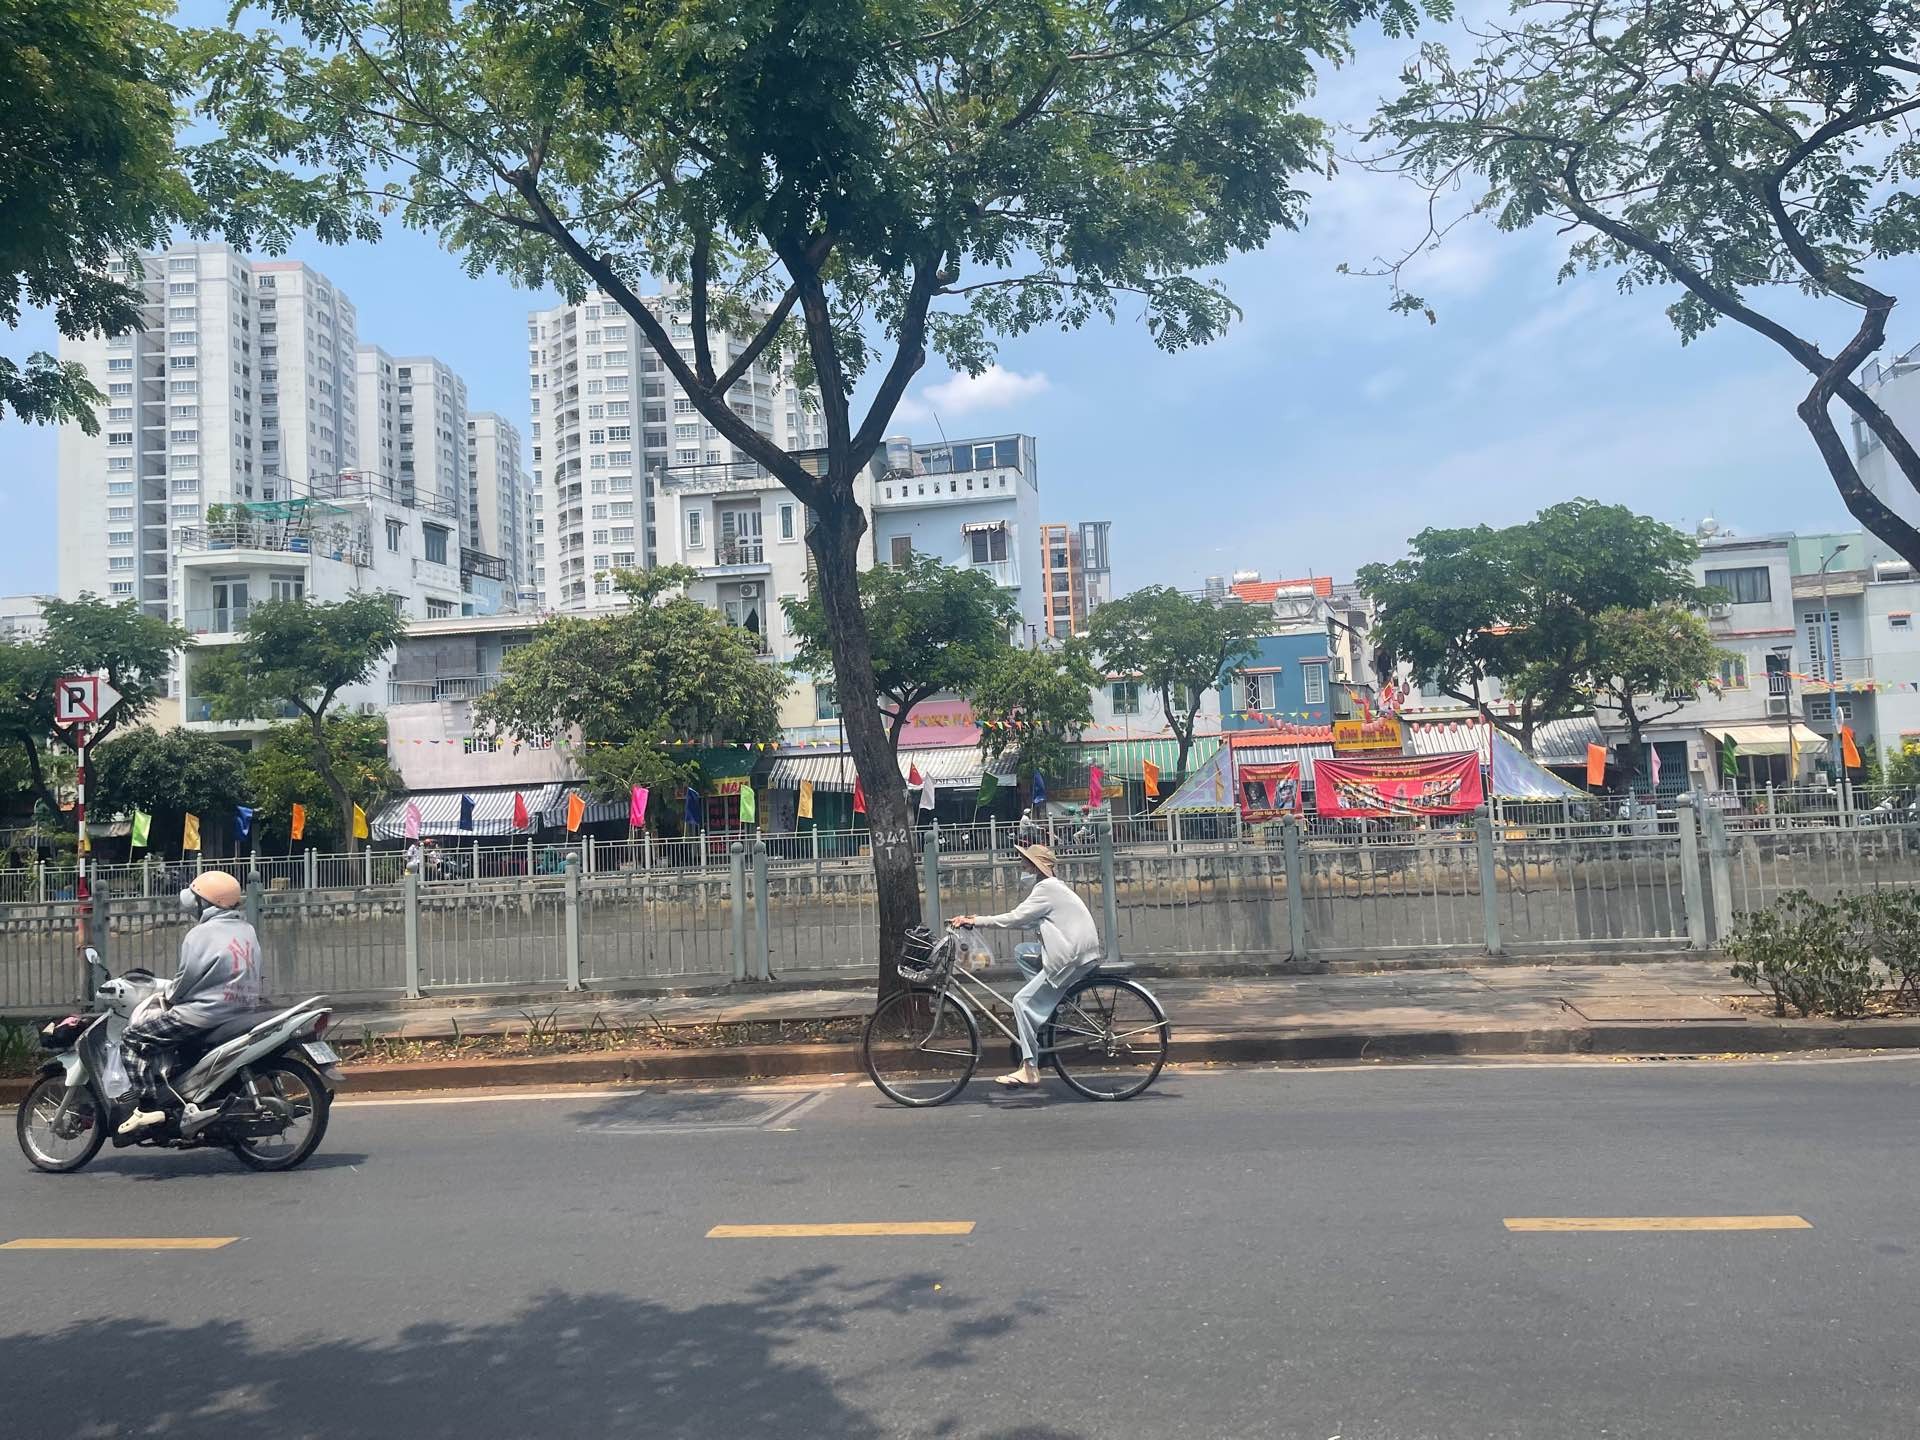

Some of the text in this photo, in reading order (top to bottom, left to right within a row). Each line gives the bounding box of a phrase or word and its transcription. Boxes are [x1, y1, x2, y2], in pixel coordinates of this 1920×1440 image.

[68, 687, 86, 713] P
[874, 828, 908, 847] 342
[885, 846, 895, 860] T
